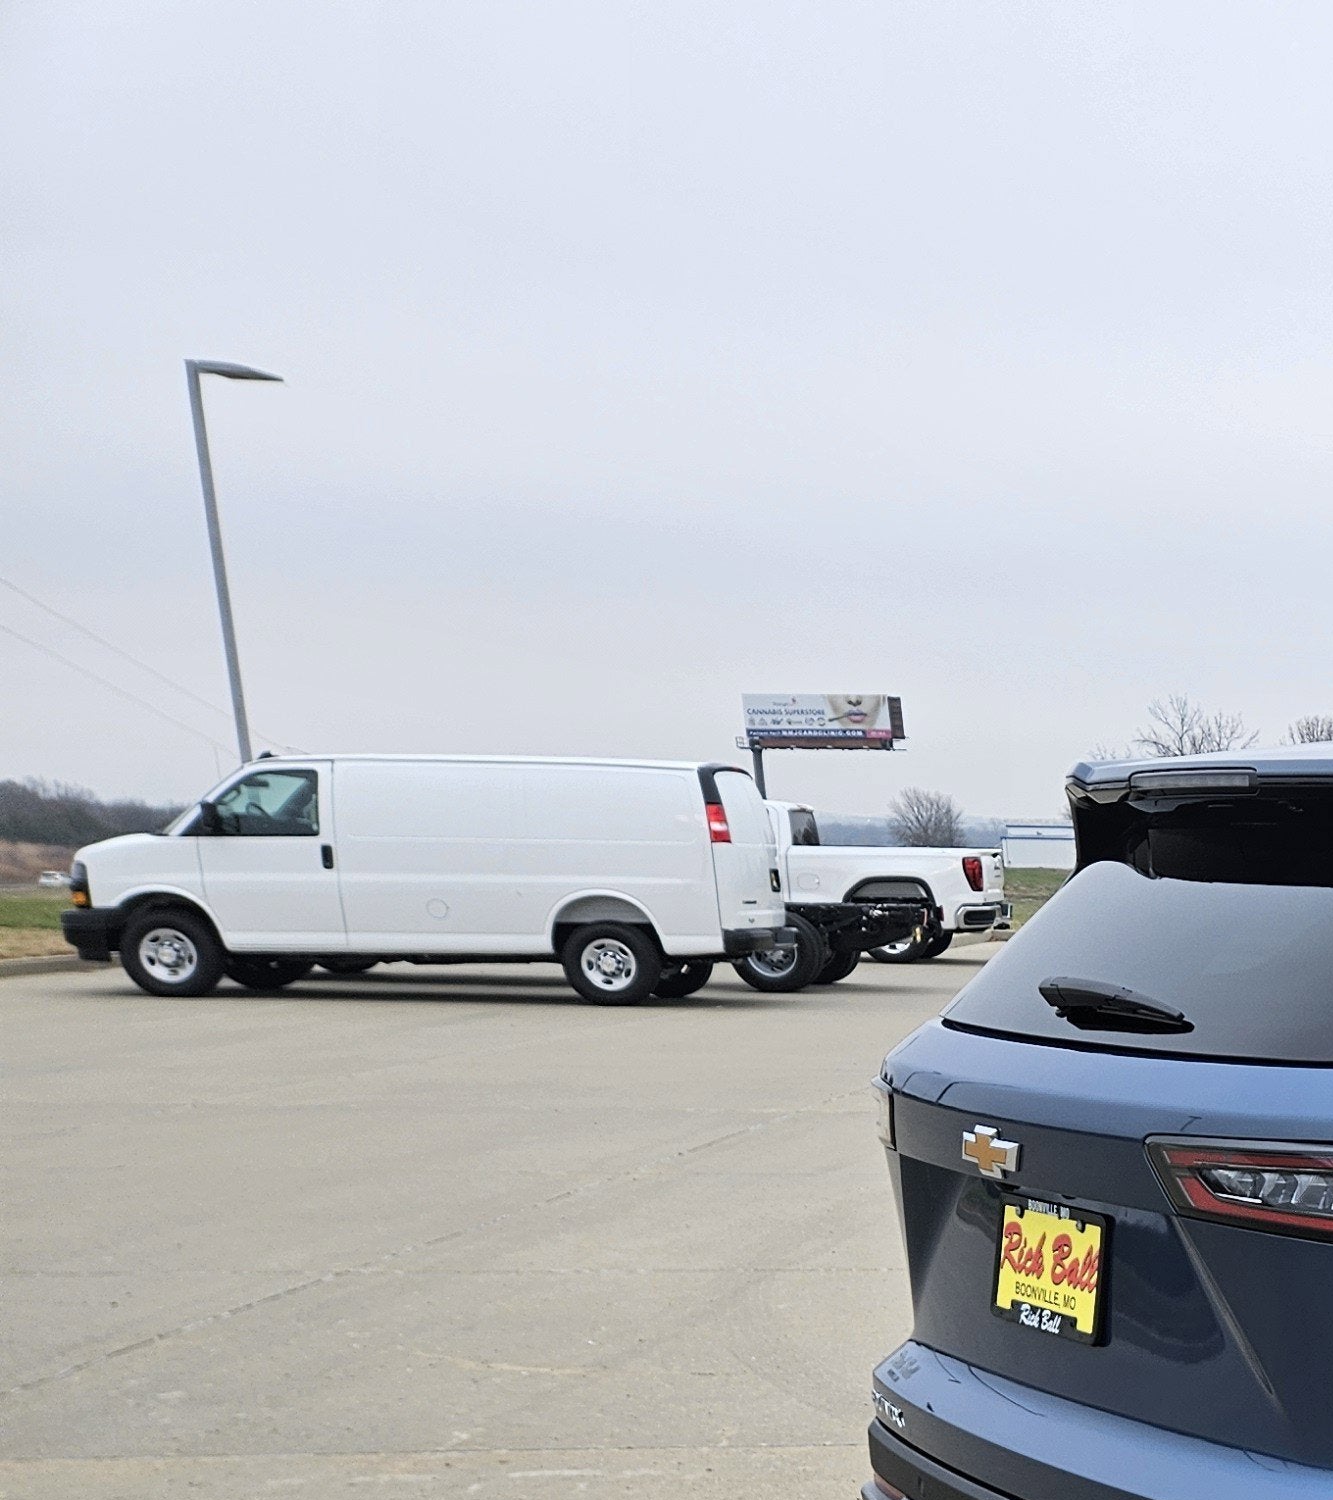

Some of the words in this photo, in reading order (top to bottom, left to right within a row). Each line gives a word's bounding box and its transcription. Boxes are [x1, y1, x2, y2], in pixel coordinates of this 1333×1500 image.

[746, 708, 783, 716] CANNABIS
[784, 708, 826, 717] SUPERSTORE
[1000, 1221, 1047, 1280] Rick
[1050, 1232, 1101, 1294] Ball
[1014, 1280, 1061, 1308] BOONVILLE,
[1062, 1293, 1077, 1311] MO
[1018, 1303, 1041, 1329] Rick
[1040, 1308, 1062, 1335] Ball
